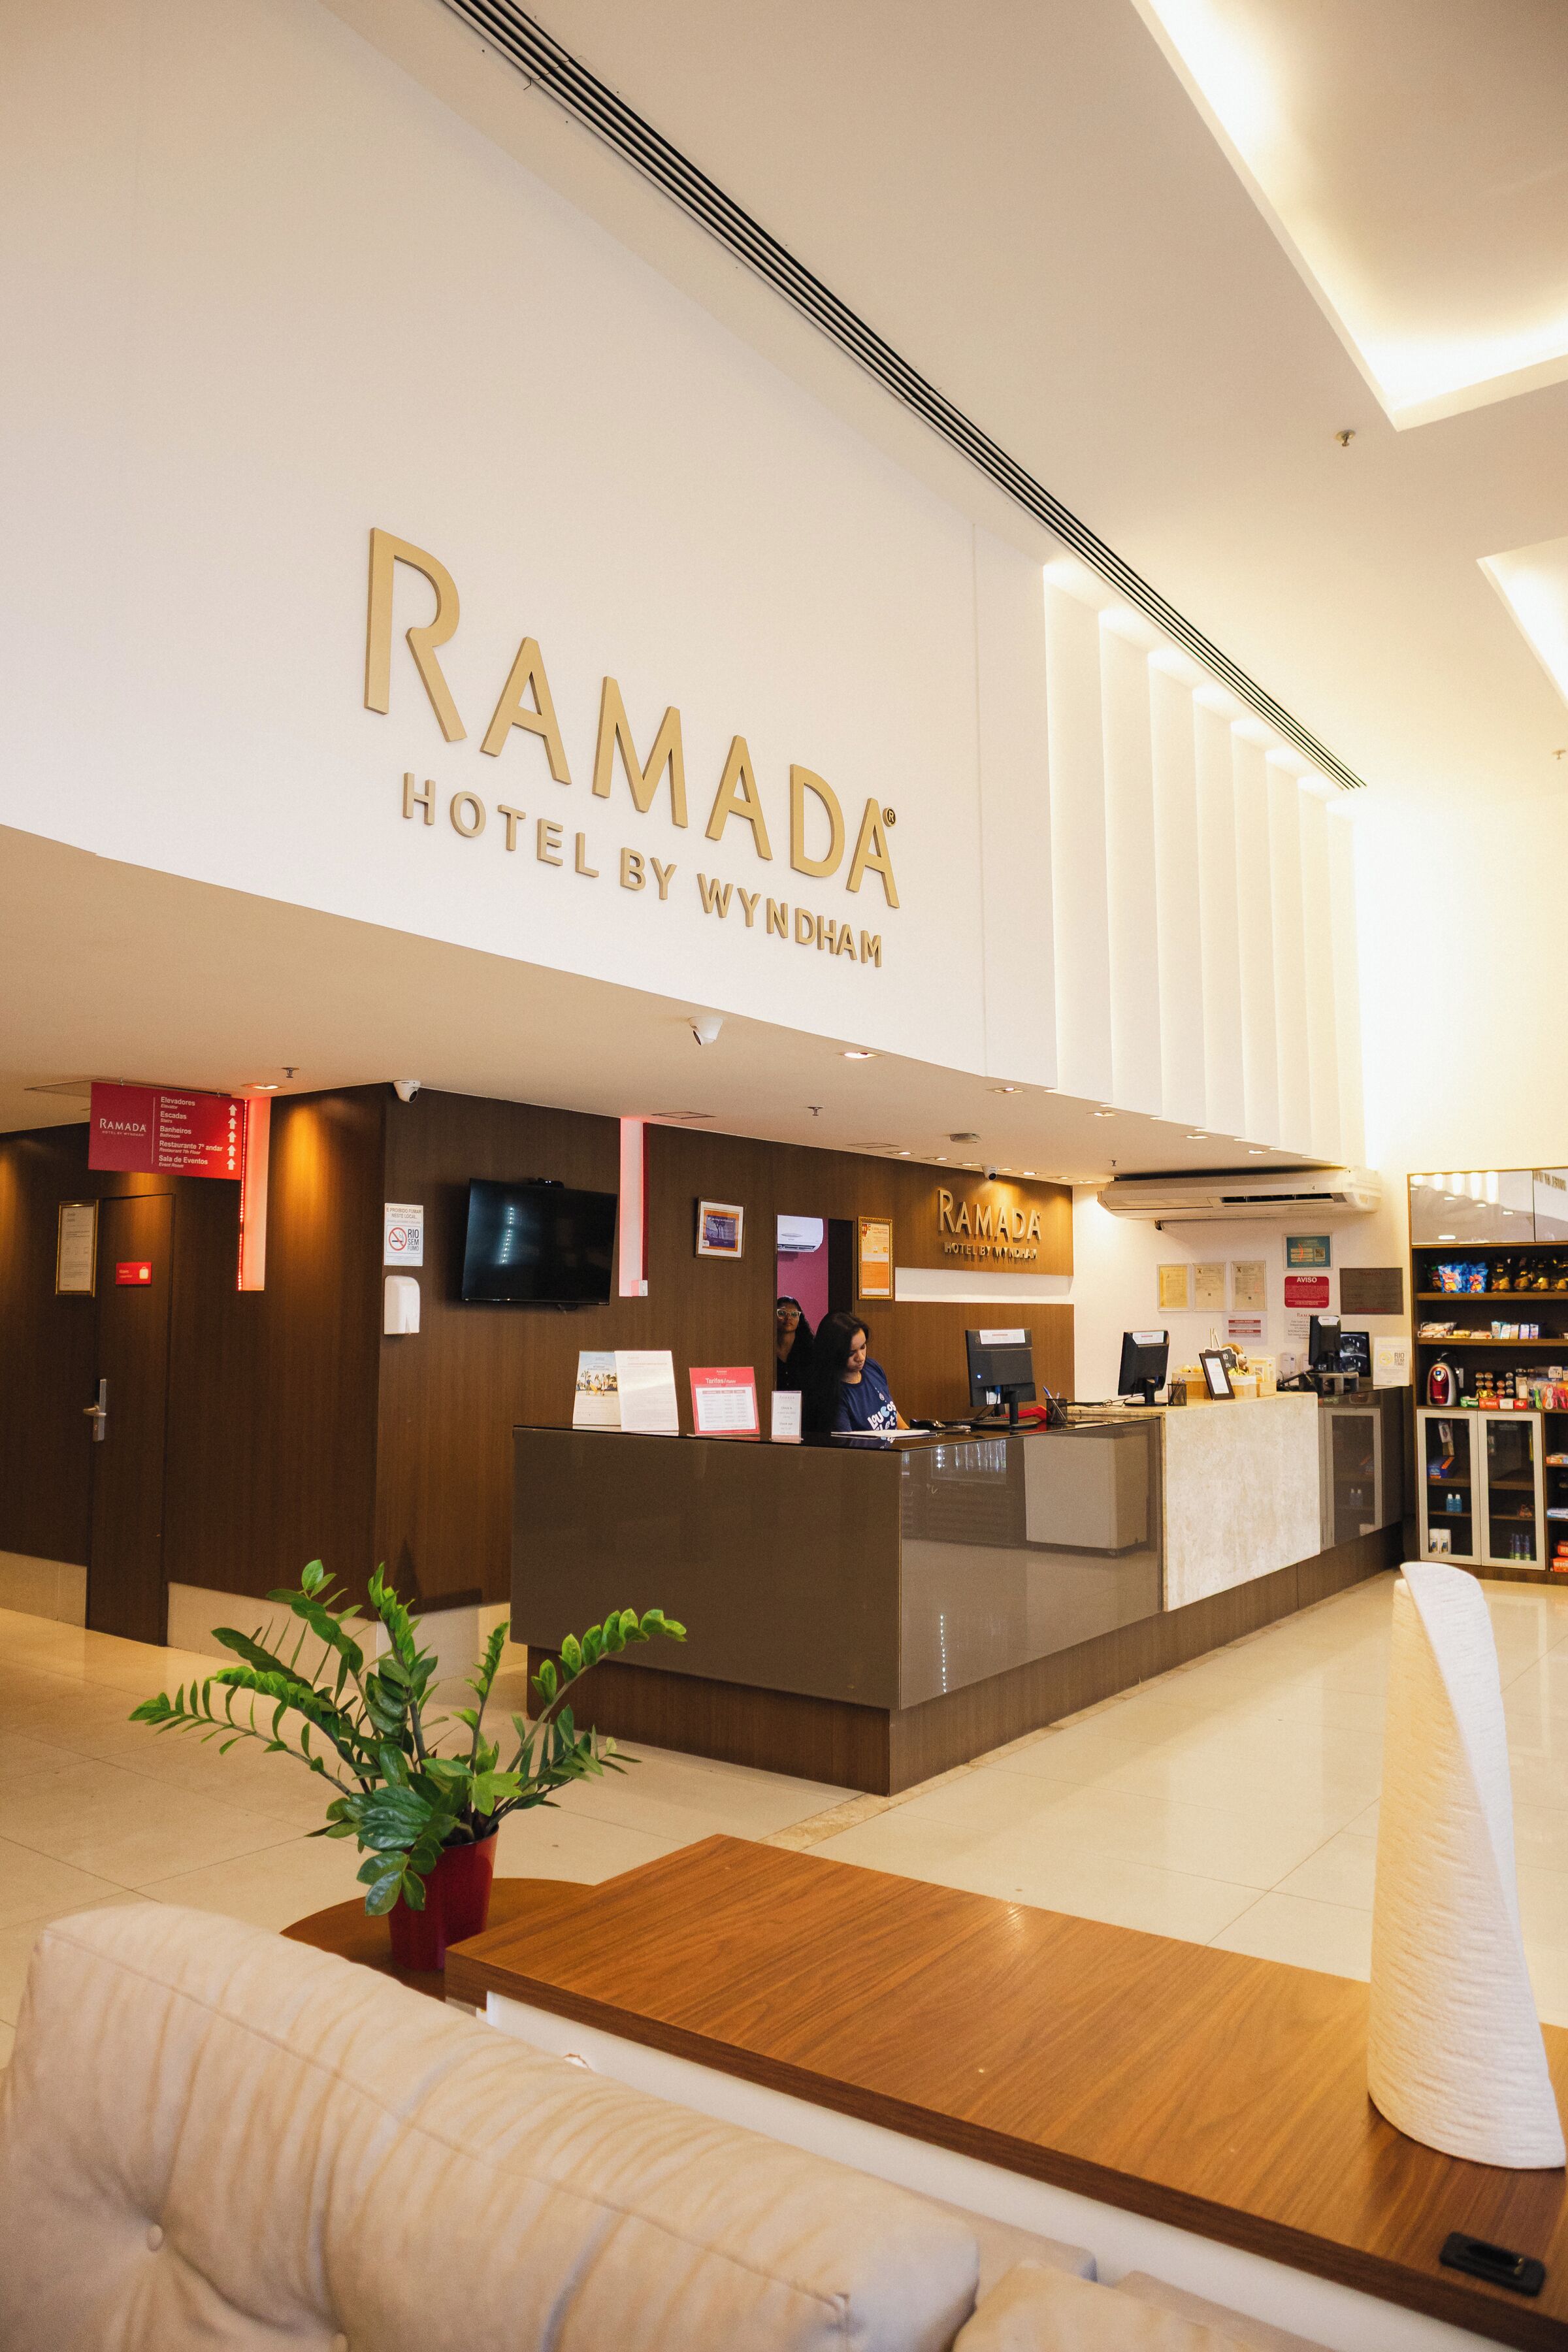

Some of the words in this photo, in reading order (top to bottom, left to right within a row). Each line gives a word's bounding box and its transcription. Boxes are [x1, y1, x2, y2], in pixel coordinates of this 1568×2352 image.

[402, 772, 599, 878] HOTEL
[620, 847, 678, 900] BY
[697, 873, 883, 968] WYNDHAM
[161, 1096, 195, 1106] Elevadores
[160, 1111, 187, 1119] Escadas
[159, 1126, 191, 1135] Banheiros
[159, 1140, 197, 1150] Restaurante
[408, 1229, 419, 1239] RIO
[944, 1242, 977, 1255] HOTEL
[979, 1245, 990, 1256] BY
[993, 1246, 1037, 1259] WYNDHAM
